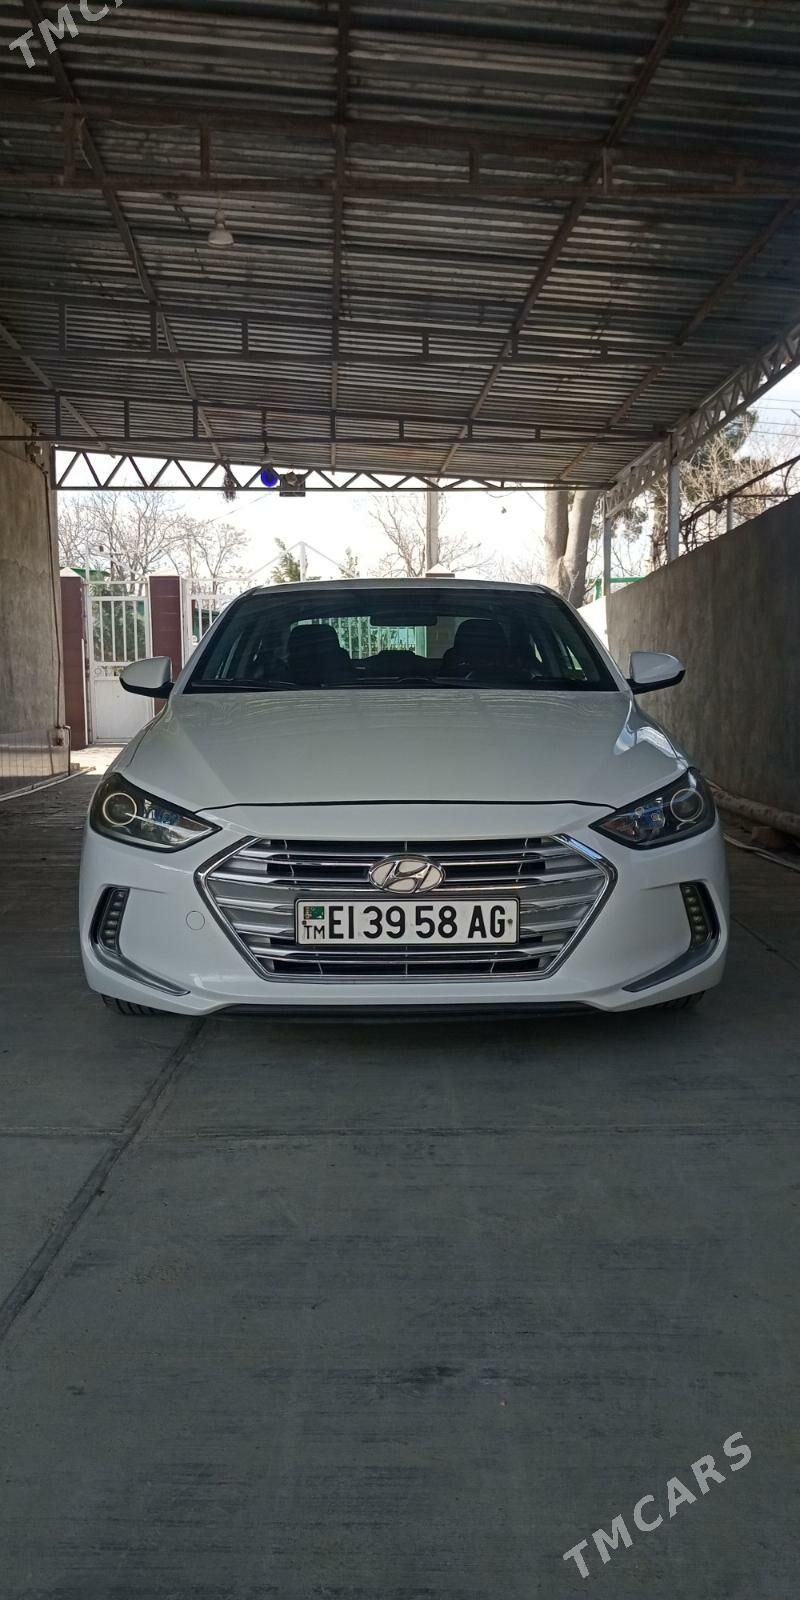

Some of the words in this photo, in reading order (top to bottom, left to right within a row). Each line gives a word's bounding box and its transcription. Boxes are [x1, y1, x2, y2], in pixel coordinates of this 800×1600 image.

[303, 925, 325, 940] TM
[363, 905, 406, 940] 39
[415, 905, 458, 939] 58
[467, 905, 506, 939] AG
